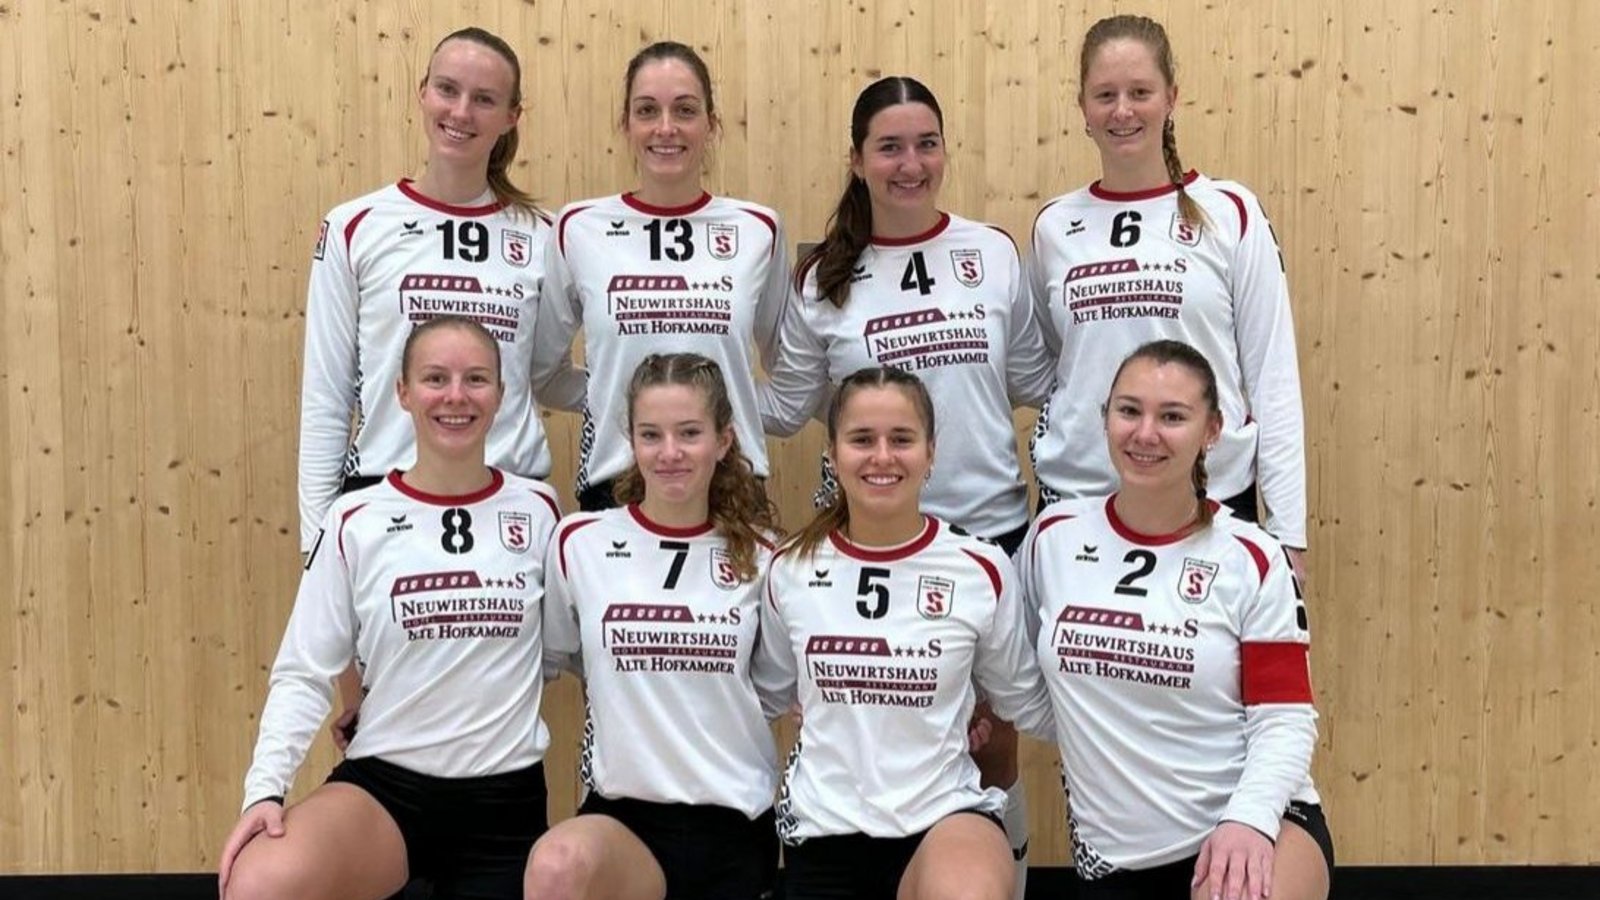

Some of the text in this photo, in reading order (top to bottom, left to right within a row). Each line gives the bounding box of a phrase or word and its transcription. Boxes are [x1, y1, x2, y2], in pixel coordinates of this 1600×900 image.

[436, 219, 489, 263] 19
[643, 219, 695, 262] 13
[1110, 211, 1142, 248] 6
[900, 251, 936, 296] 4
[1070, 279, 1183, 300] NEUWIRTSHAUS
[408, 296, 520, 319] NEUWIRTSHAUS
[616, 297, 731, 311] NEUWIRTSHAUS
[1072, 305, 1179, 325] ALTE HOFKAMMER
[618, 321, 729, 336] ALTE HOFKAMMER
[875, 327, 988, 352] NEUWIRTSHAUS
[916, 352, 989, 371] HOFKAMMER
[441, 508, 474, 554] 8
[659, 540, 690, 590] 7
[1114, 549, 1157, 597] 2
[856, 567, 891, 620] 5
[401, 598, 524, 617] NEUWIRTSHAUS
[438, 624, 520, 639] HOFKAMMER
[611, 629, 738, 647] NEUWIRTSHAUS
[1060, 629, 1195, 662] NEUWIRTSHAUS
[615, 657, 735, 674] ALTE HOFKAMMER
[813, 660, 938, 681] NEUWIRTSHAUS
[1059, 658, 1191, 689] ALTE HOFKAMMER
[821, 690, 935, 708] ALTE HOFKAMMER
